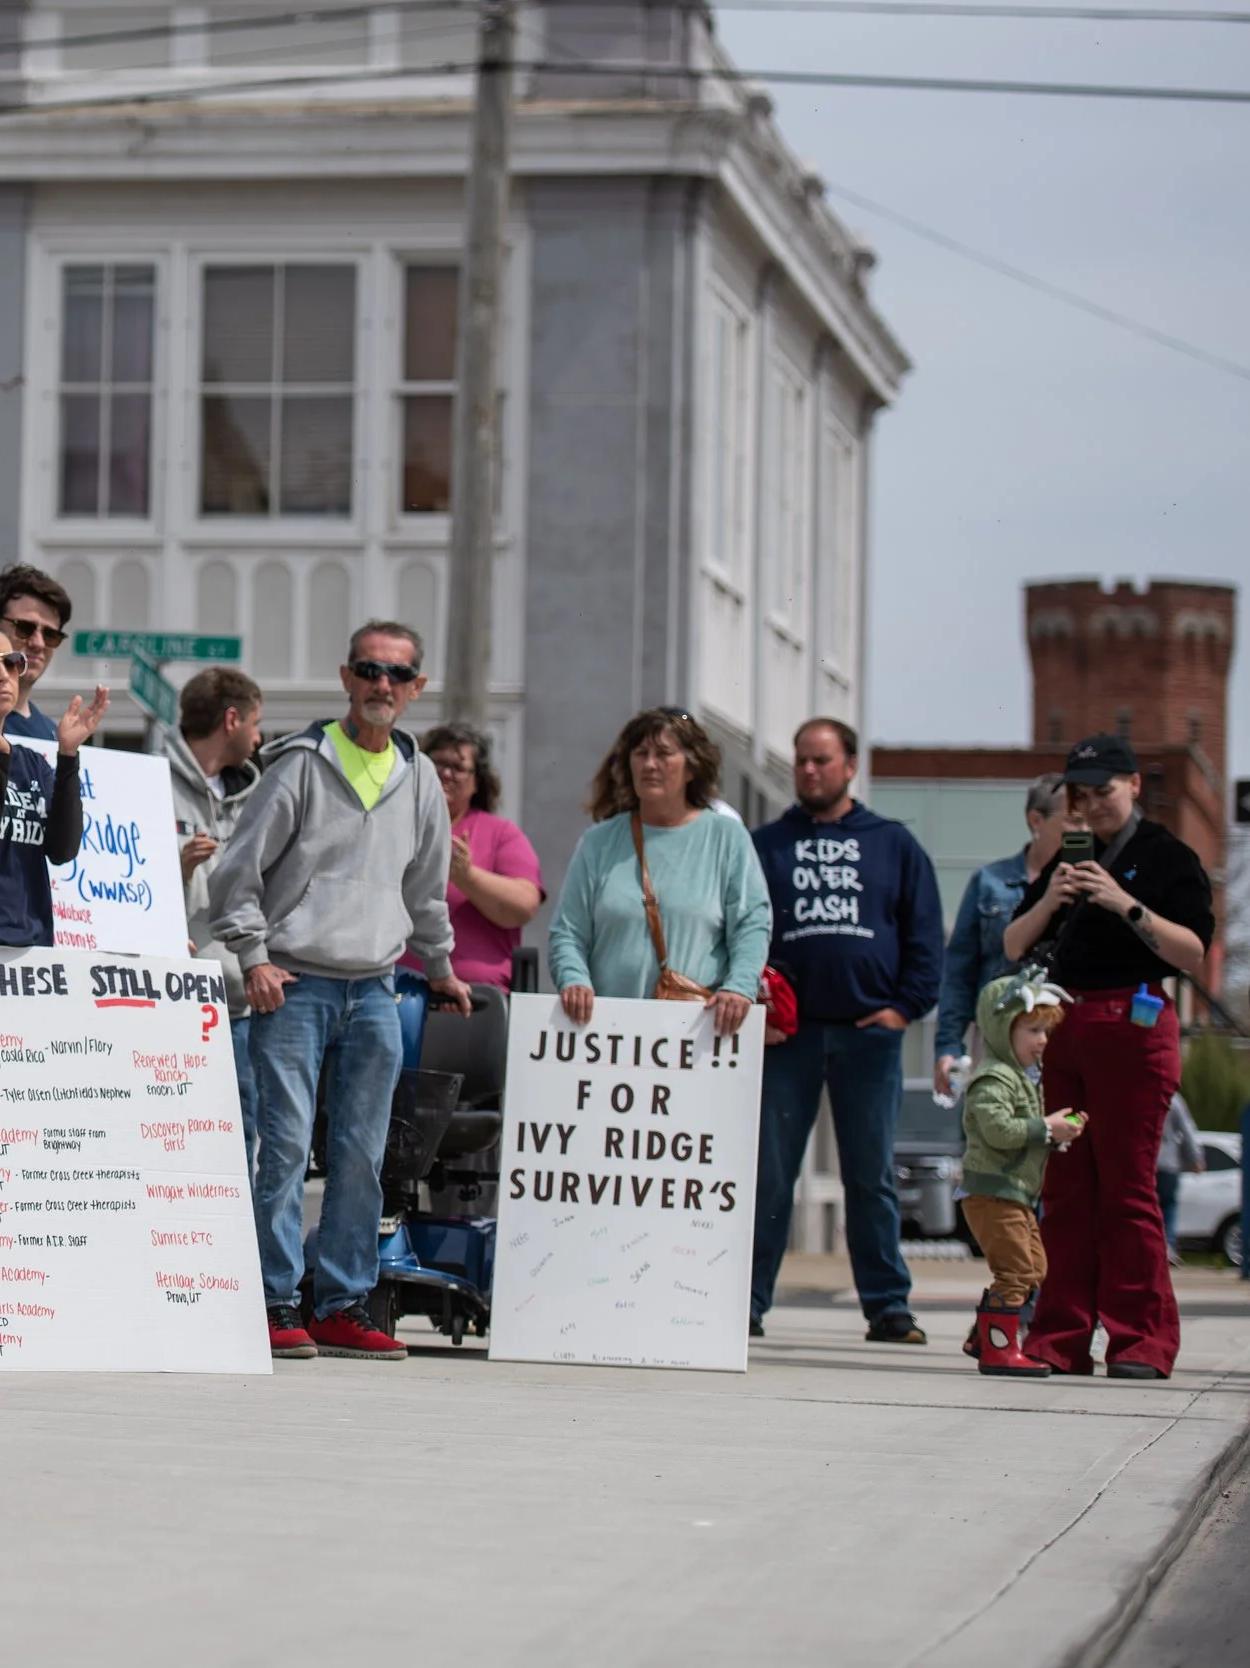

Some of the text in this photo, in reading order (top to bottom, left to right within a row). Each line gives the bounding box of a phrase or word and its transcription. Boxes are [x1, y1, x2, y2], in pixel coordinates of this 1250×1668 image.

[795, 838, 861, 863] KIDS
[792, 864, 864, 892] OVER
[78, 868, 152, 912] (WWASP)
[794, 894, 859, 924] CASH
[90, 965, 161, 1000] STILL
[165, 972, 226, 1004] OPEN
[201, 1004, 219, 1042] ?
[26, 1048, 46, 1064] Rica
[133, 1051, 207, 1068] Renewed Hope
[530, 1030, 694, 1070] JUSTICE
[154, 1068, 188, 1082] Ranch
[28, 1088, 50, 1102] Olsen
[100, 1087, 131, 1100] Nephew
[178, 1082, 193, 1096] UT
[577, 1080, 672, 1116] FOR
[141, 1123, 184, 1140] Discovery
[188, 1119, 214, 1134] Ranch
[44, 1140, 81, 1154] Brightway
[164, 1138, 185, 1152] Girls
[517, 1122, 714, 1164] IVY RIDGE
[22, 1169, 140, 1182] Former Cross Creek therapists
[146, 1182, 240, 1202] Wingate Wilderness
[510, 1168, 737, 1212] SURVIVER'S
[15, 1199, 136, 1216] Former Cross Creek therapists
[150, 1230, 213, 1246] Sunrise RTC
[156, 1272, 239, 1291] Heritage Schools
[17, 1302, 55, 1320] Academy
